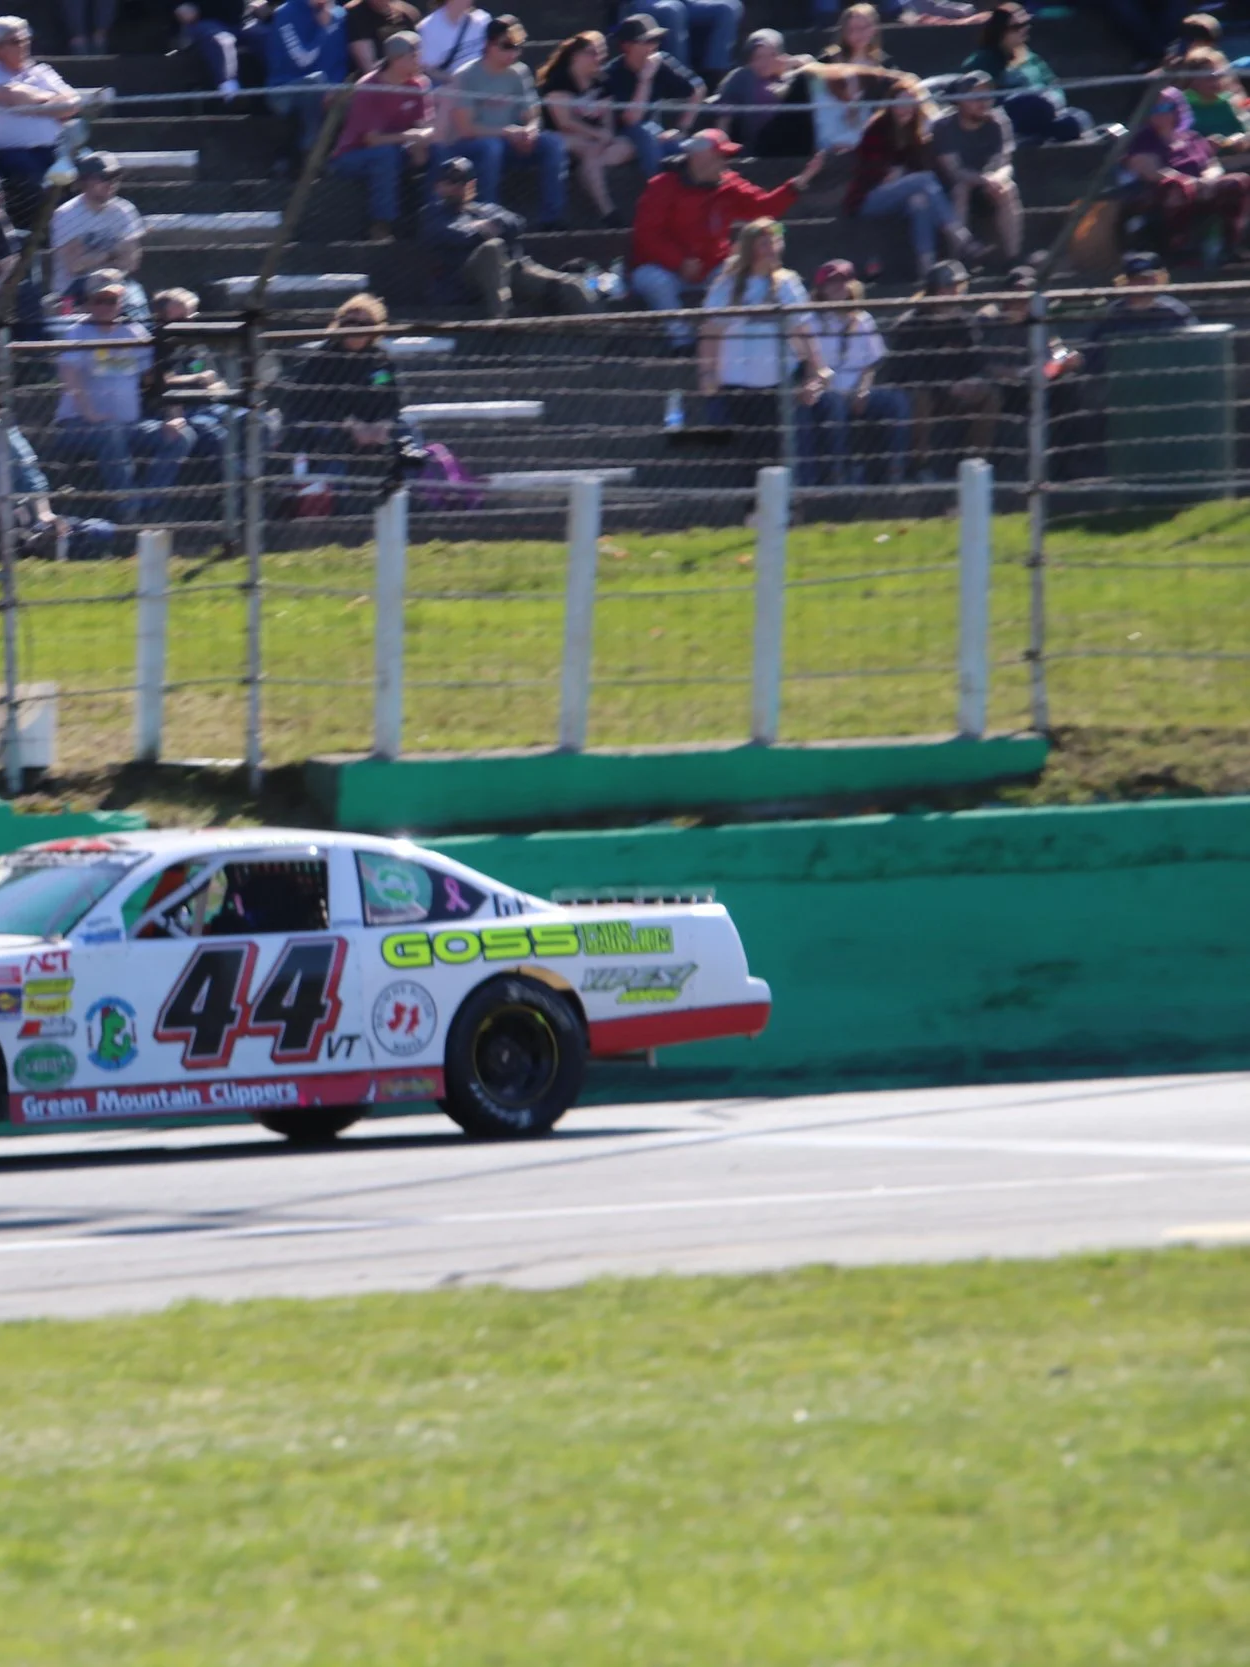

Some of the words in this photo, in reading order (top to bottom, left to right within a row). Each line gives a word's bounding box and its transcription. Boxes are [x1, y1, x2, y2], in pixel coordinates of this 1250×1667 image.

[25, 951, 70, 973] ACT
[381, 922, 581, 969] GOSS
[154, 936, 349, 1070] 44
[326, 1034, 361, 1060] VT
[21, 1094, 88, 1117] Green
[95, 1084, 201, 1112] Mountain
[208, 1079, 298, 1107] Clippers
